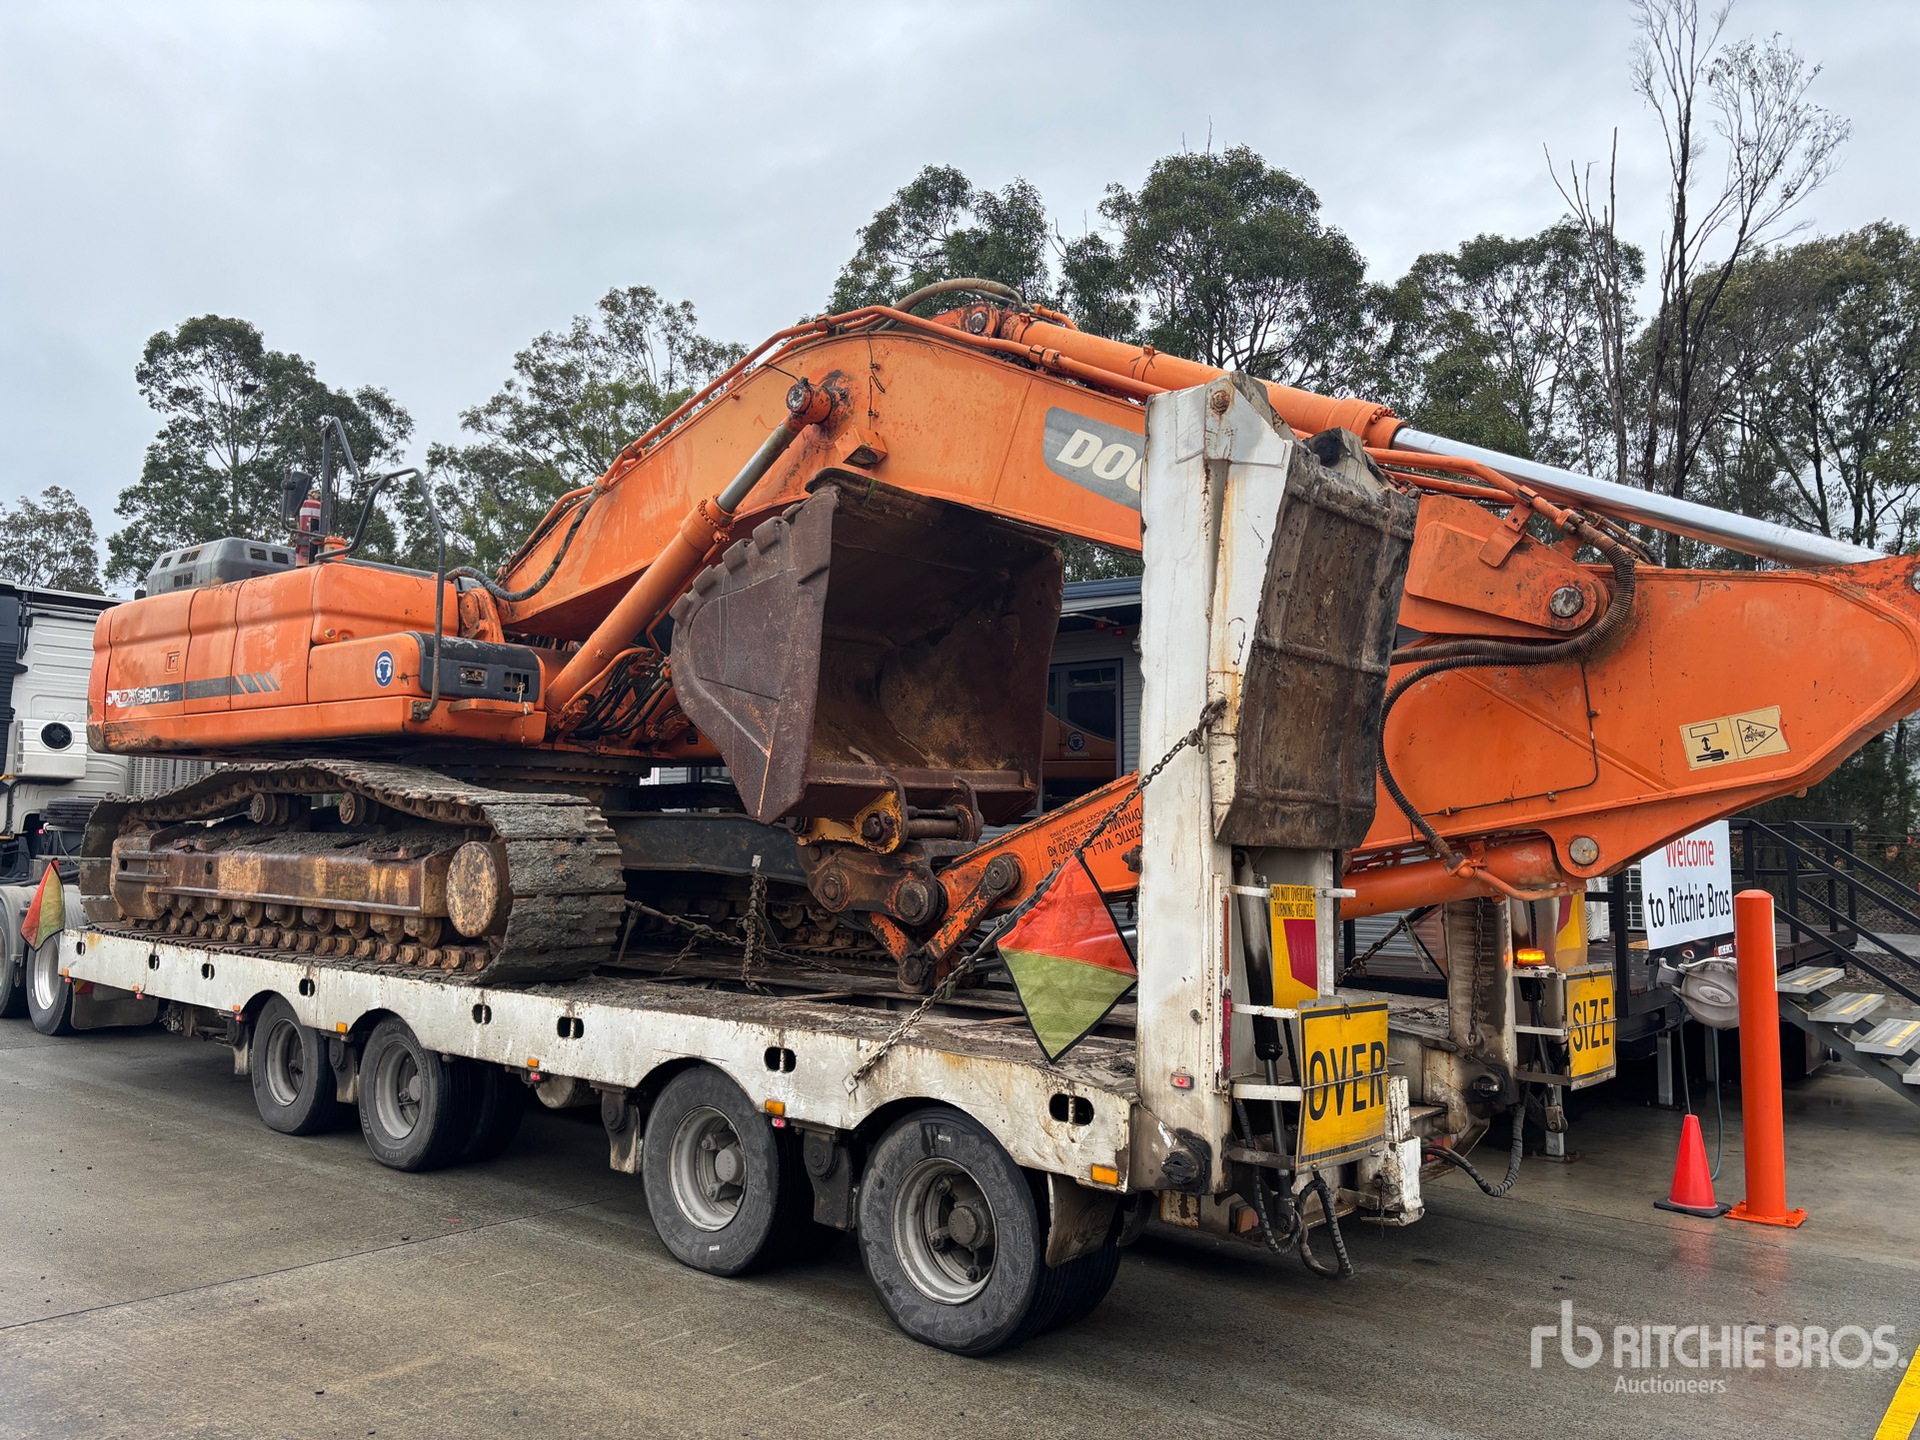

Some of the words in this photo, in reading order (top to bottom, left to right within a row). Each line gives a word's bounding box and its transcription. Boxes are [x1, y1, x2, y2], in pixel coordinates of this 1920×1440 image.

[1047, 845, 1058, 857] kg
[1058, 836, 1080, 855] 3800
[1665, 836, 1714, 868] Welcome
[1273, 886, 1280, 901] DO
[1281, 886, 1290, 901] NOT
[1291, 887, 1314, 902] OVERTAKE
[1648, 892, 1665, 928] to
[1668, 882, 1705, 925] Ritchie
[1707, 883, 1731, 918] Bros.
[1274, 902, 1294, 917] TURNING
[1296, 903, 1314, 918] VEHICLE
[1572, 997, 1610, 1052] SIZE
[1309, 1040, 1386, 1121] OVER
